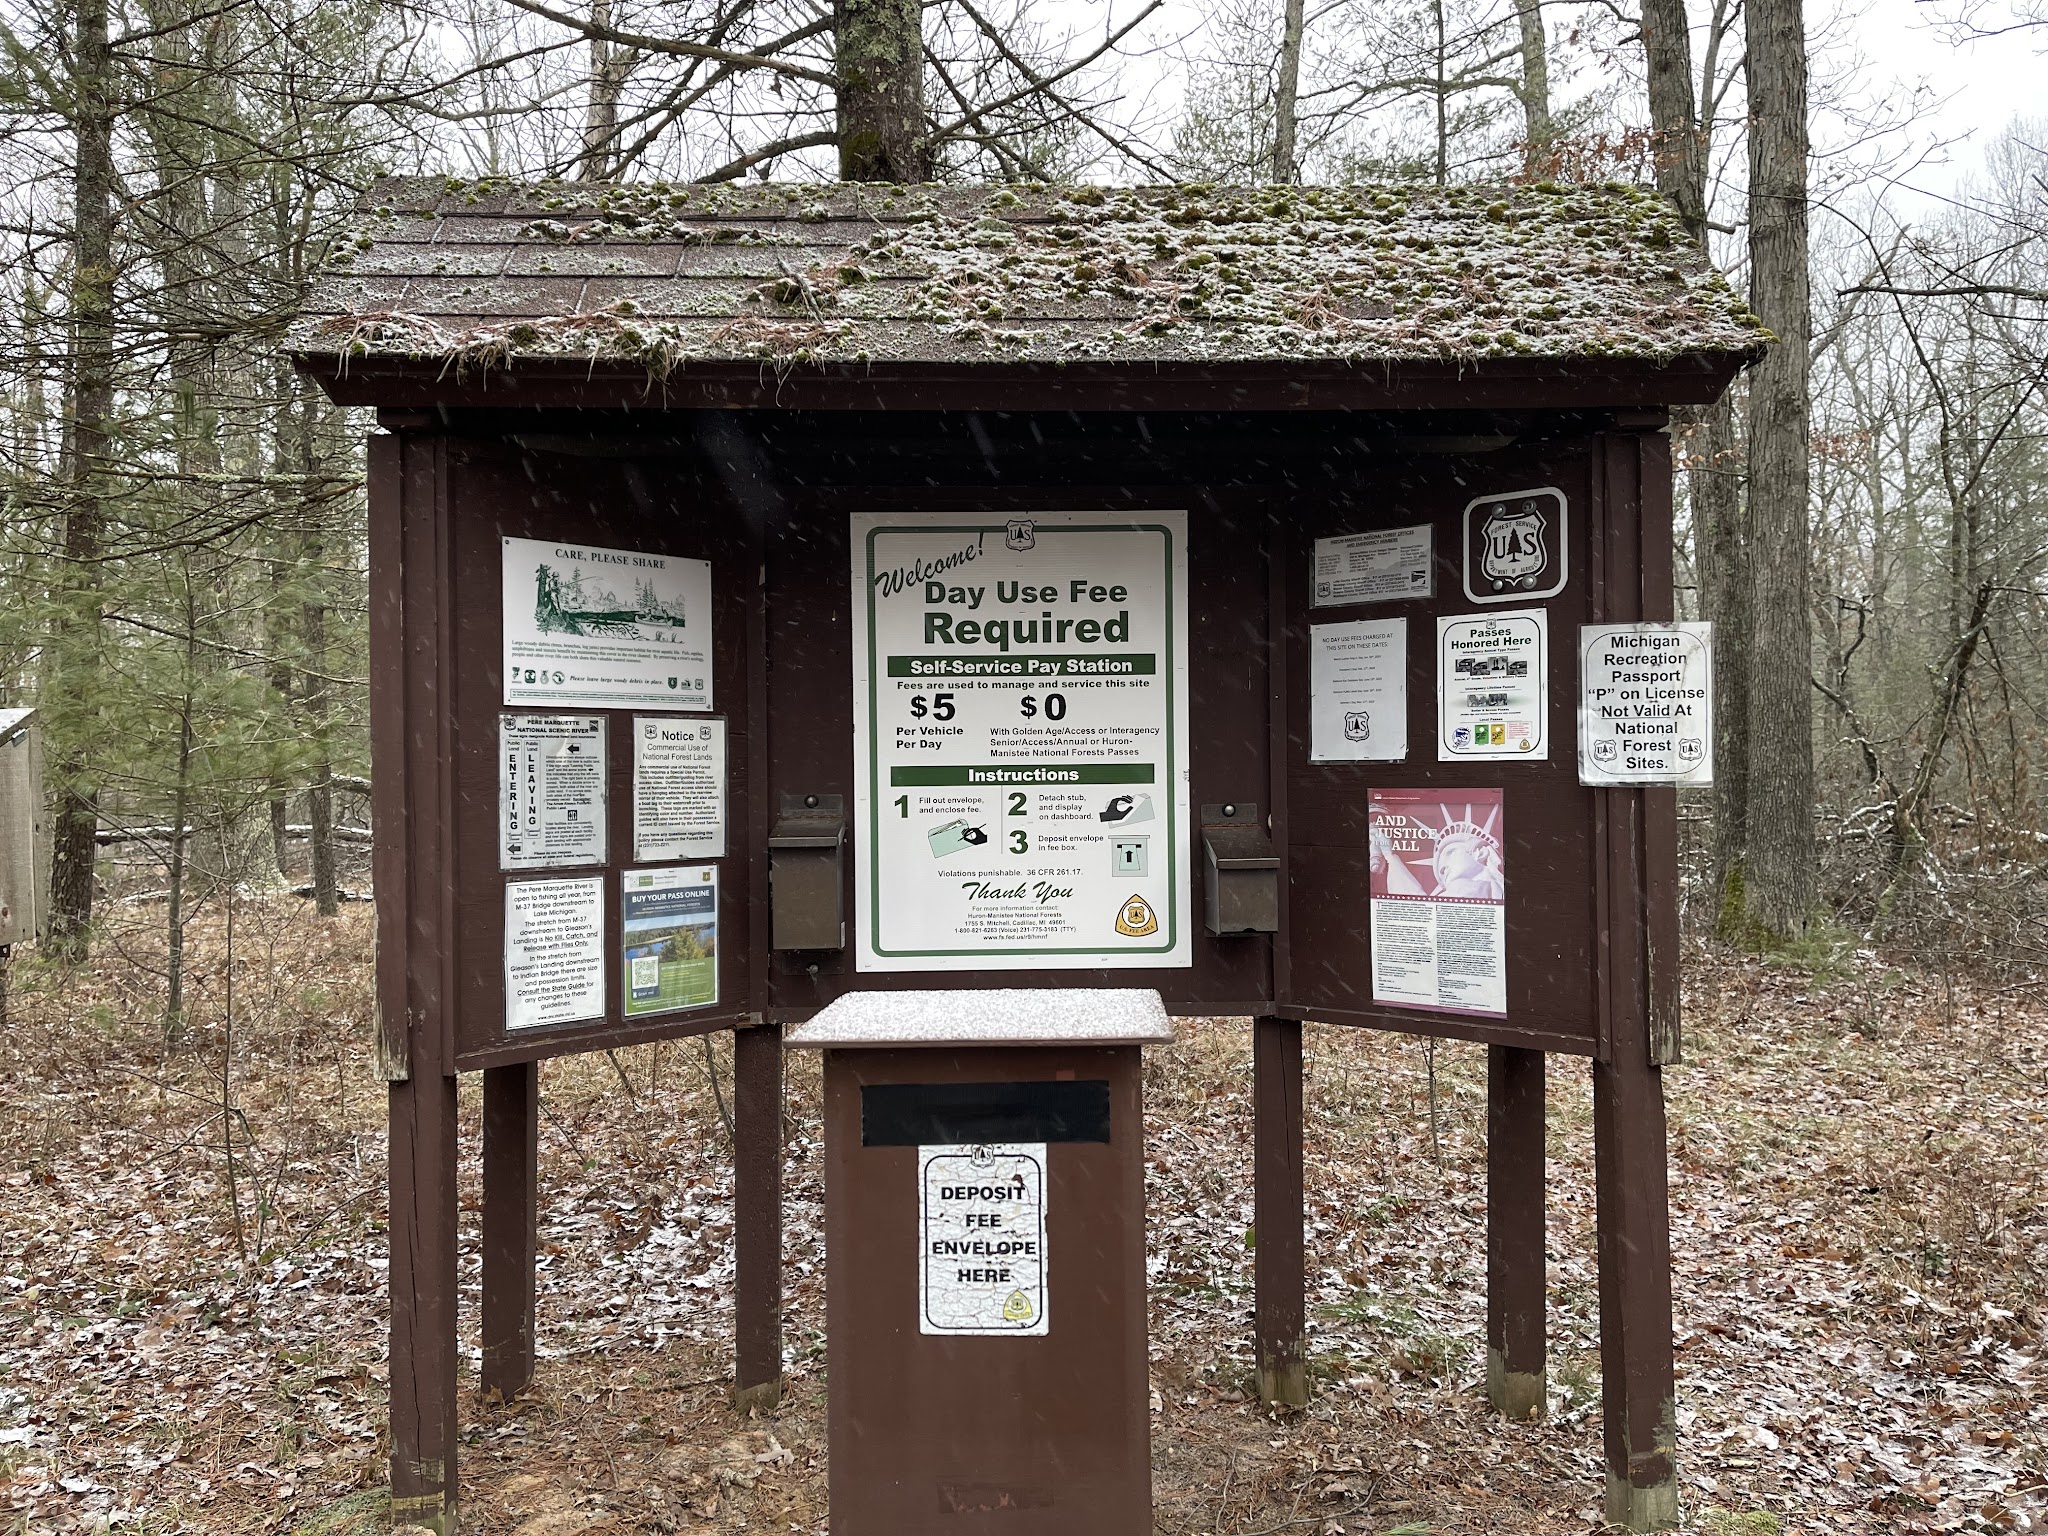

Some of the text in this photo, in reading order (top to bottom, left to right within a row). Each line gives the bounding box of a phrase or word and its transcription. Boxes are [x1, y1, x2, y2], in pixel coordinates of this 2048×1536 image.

[1490, 521, 1537, 535] FOREST SERVICE
[556, 549, 666, 570] CARE, PLEASE SHARE
[875, 532, 984, 598] Welcome!
[925, 580, 1127, 610] Day Use Fee
[924, 610, 1129, 652] Required
[1470, 629, 1511, 638] Passes
[1451, 637, 1531, 649] Honored Here
[1611, 635, 1680, 649] Michigan
[1604, 653, 1687, 666] Recreation
[910, 659, 1133, 676] Self-Service Pay Station
[1612, 670, 1681, 684] Passport
[948, 681, 973, 689] used
[992, 682, 1034, 690] manage
[1038, 680, 1058, 688] and
[1062, 680, 1102, 688] service
[1129, 679, 1150, 687] site
[1620, 690, 1640, 700] on
[1645, 687, 1705, 699] License
[1601, 704, 1692, 718] Not Valid At
[896, 727, 963, 735] Per Vehicle
[990, 728, 1010, 736] With
[1046, 727, 1095, 736] Age/Access
[1110, 727, 1160, 735] Interagency
[1615, 722, 1678, 734] National
[662, 731, 694, 740] Notice
[991, 738, 1087, 746] Senior/Access/Annual
[896, 740, 942, 750] Per Day
[1623, 740, 1671, 752] Forest
[1626, 757, 1668, 769] Sites.
[968, 768, 1080, 782] Instructions
[509, 754, 518, 830] ENTERING
[528, 754, 536, 824] LEAVING
[894, 795, 908, 818] 1
[1008, 792, 1027, 816] 2
[1068, 794, 1086, 802] stub,
[1375, 816, 1406, 826] AND
[1375, 828, 1437, 839] JUSTICE
[1009, 830, 1028, 854] 3
[1392, 841, 1420, 852] ALL
[979, 870, 1022, 878] punishable.
[543, 885, 573, 893] Marquette
[962, 881, 1073, 904] Thank You
[632, 895, 646, 903] BUY
[668, 892, 684, 900] PASS
[685, 890, 710, 898] ONLINE
[941, 1186, 1025, 1200] DEPOSIT
[966, 1214, 1002, 1227] FEE
[932, 1241, 1036, 1255] ENVELOPE
[957, 1269, 1011, 1282] HERE
